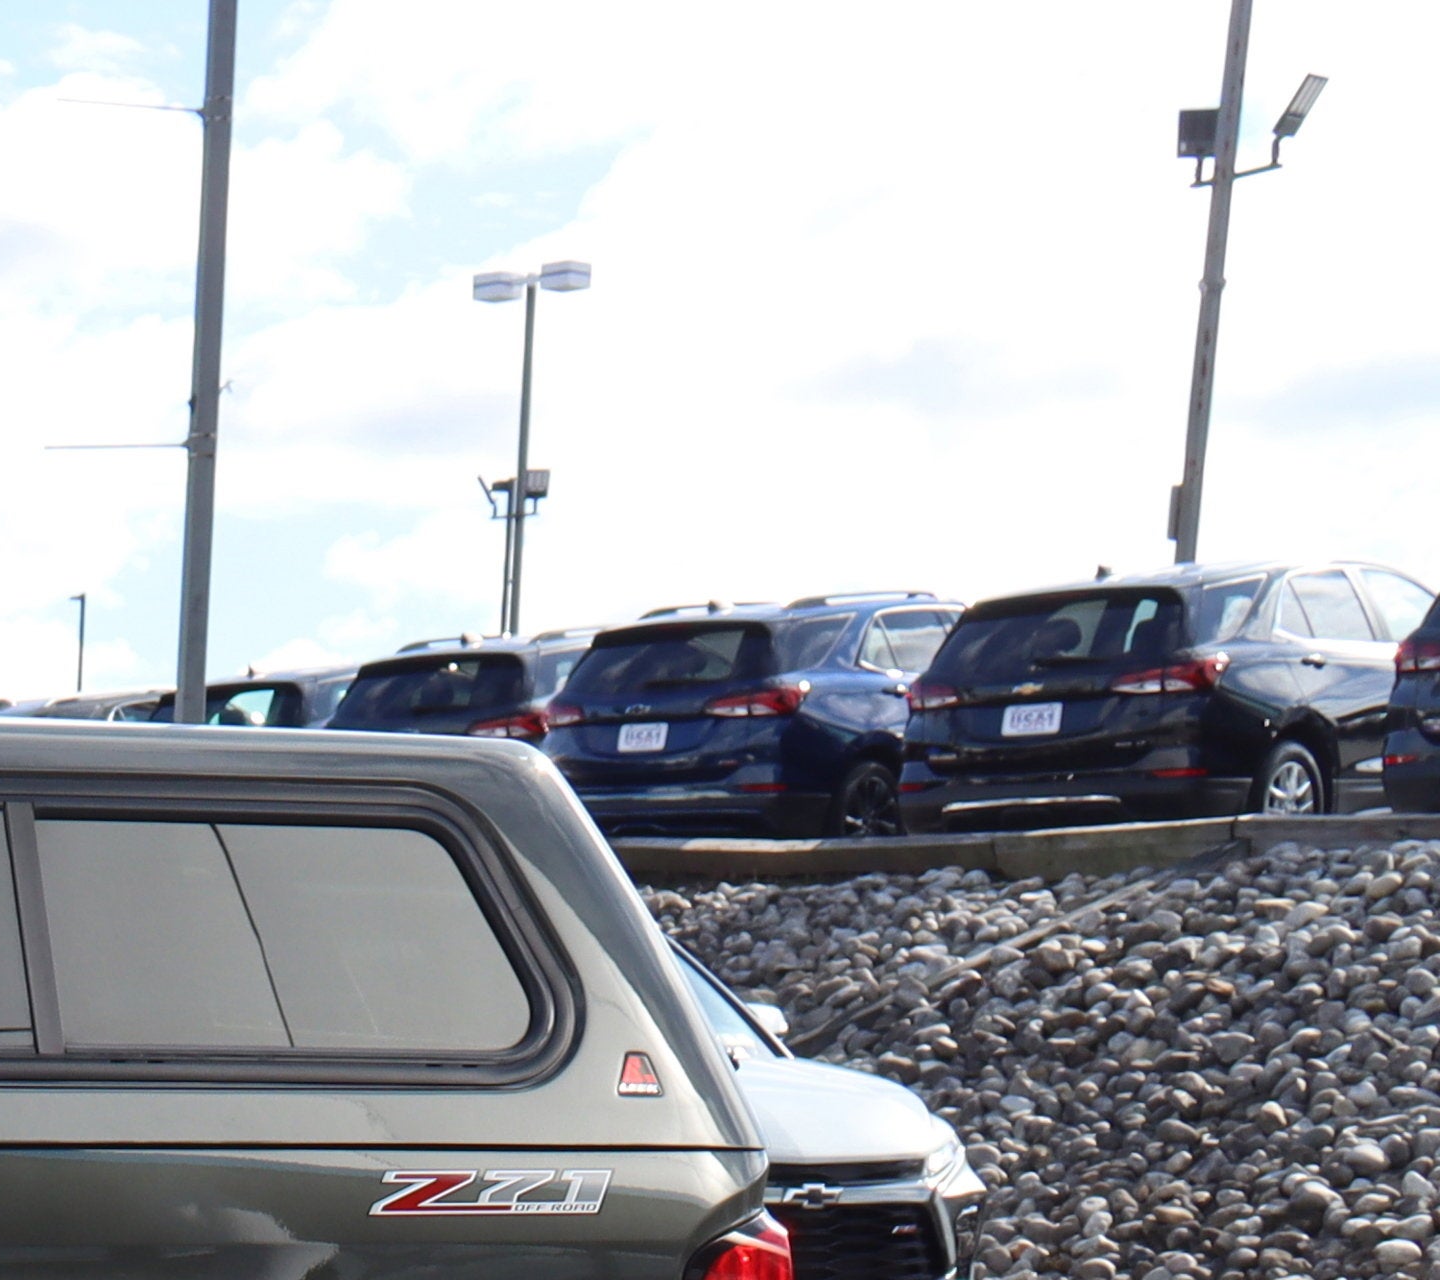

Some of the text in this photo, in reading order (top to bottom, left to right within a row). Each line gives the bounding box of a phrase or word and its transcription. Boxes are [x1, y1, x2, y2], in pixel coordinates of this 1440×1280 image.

[368, 1169, 613, 1216] Z71
[514, 1203, 597, 1212] OFF ROAD
